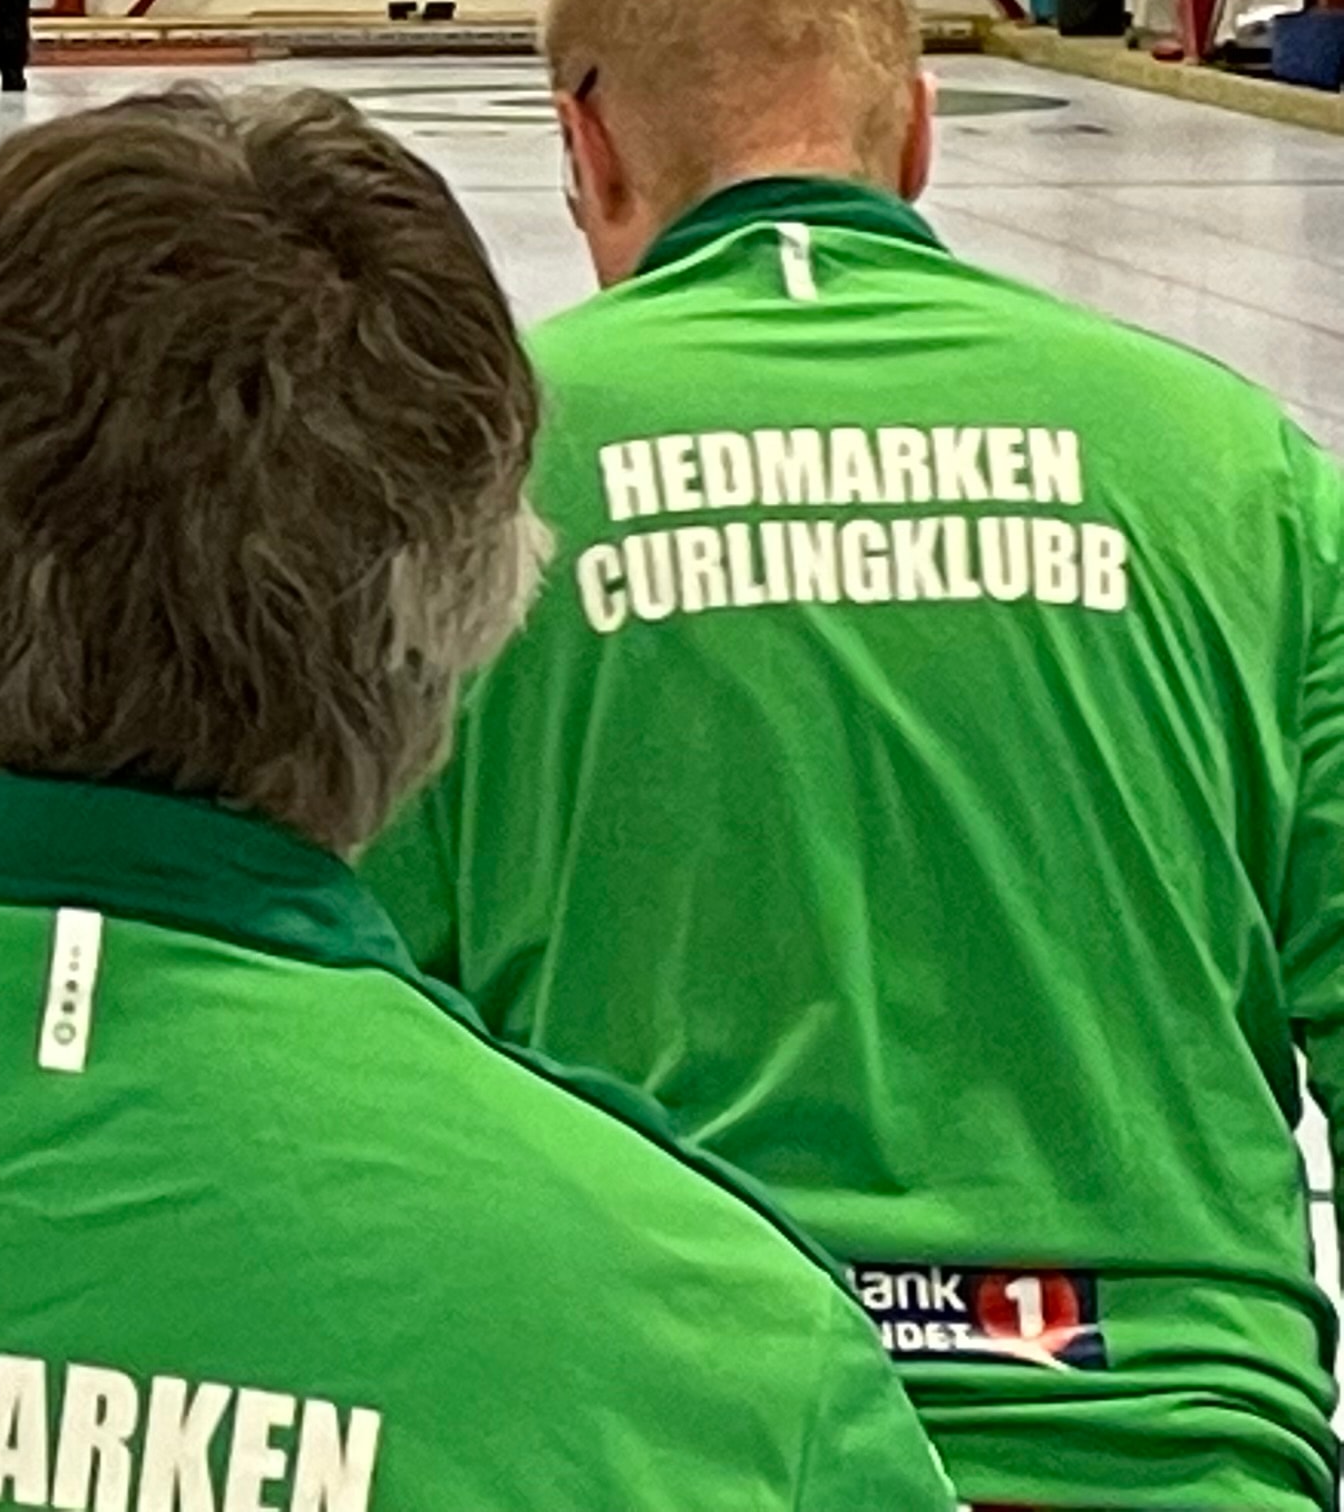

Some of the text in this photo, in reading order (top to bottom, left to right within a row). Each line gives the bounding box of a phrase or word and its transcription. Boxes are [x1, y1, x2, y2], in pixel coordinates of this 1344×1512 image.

[599, 425, 1084, 522] HEDMARKEN
[575, 515, 1130, 636] CURLINGKLUBB
[845, 1267, 1045, 1340] ank 1
